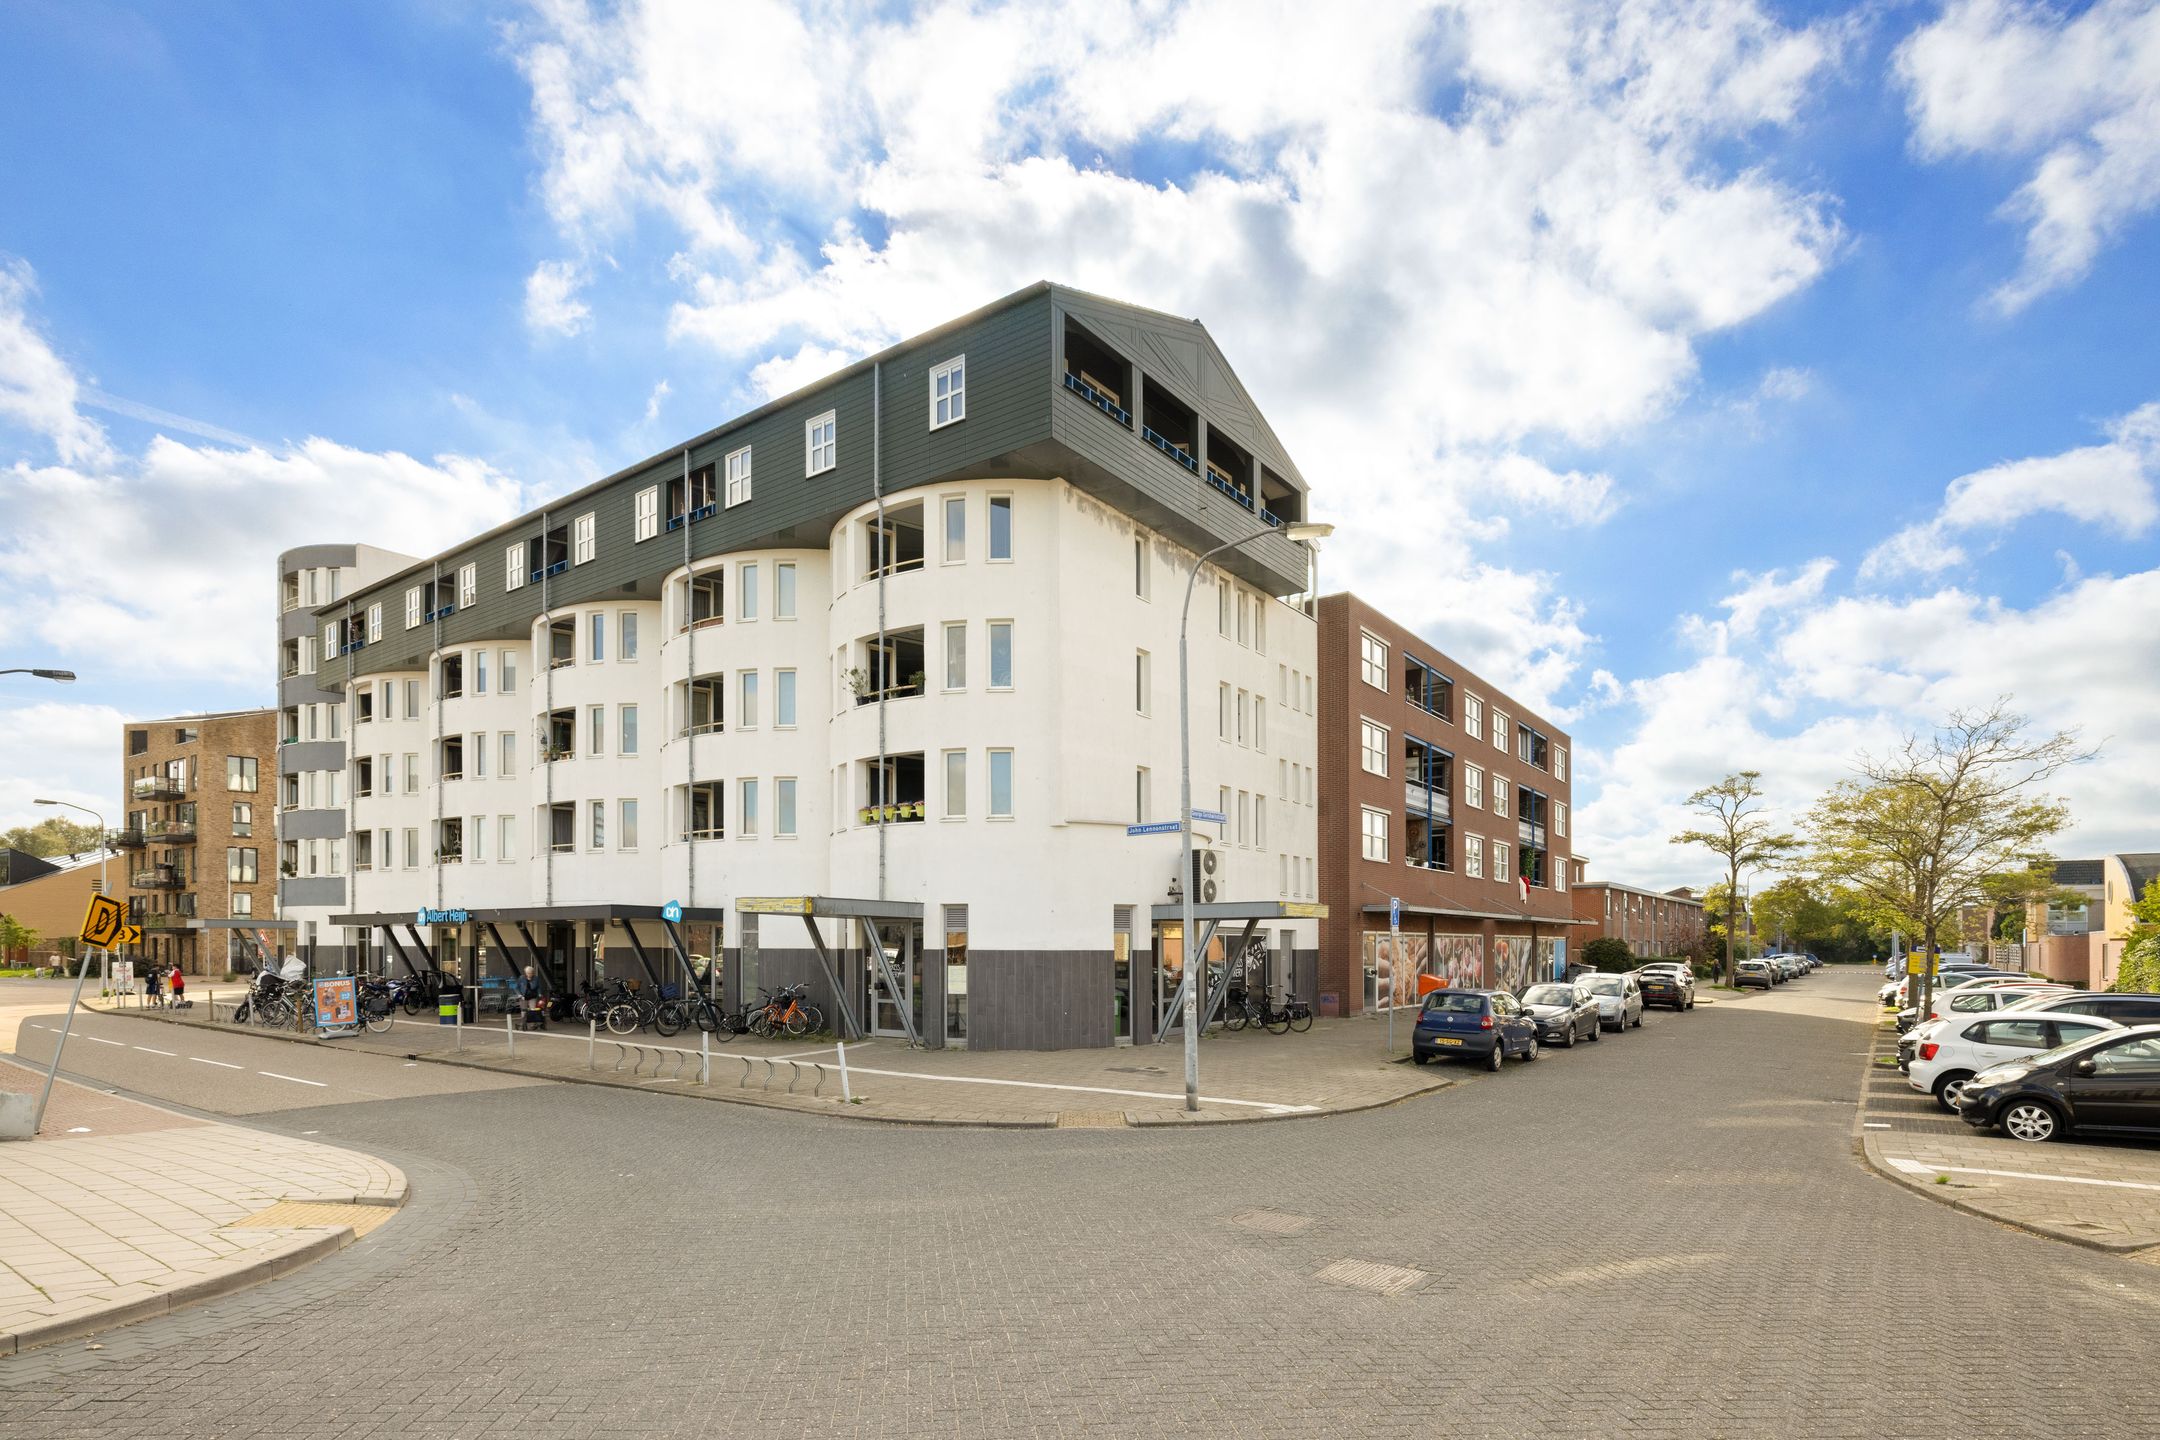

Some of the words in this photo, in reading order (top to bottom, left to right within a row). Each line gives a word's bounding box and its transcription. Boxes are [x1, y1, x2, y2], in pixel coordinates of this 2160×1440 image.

[1142, 824, 1178, 832] Lennonstraat
[95, 907, 110, 935] D
[427, 909, 448, 922] Albert
[449, 908, 467, 924] Heijn
[324, 980, 351, 988] BONUS
